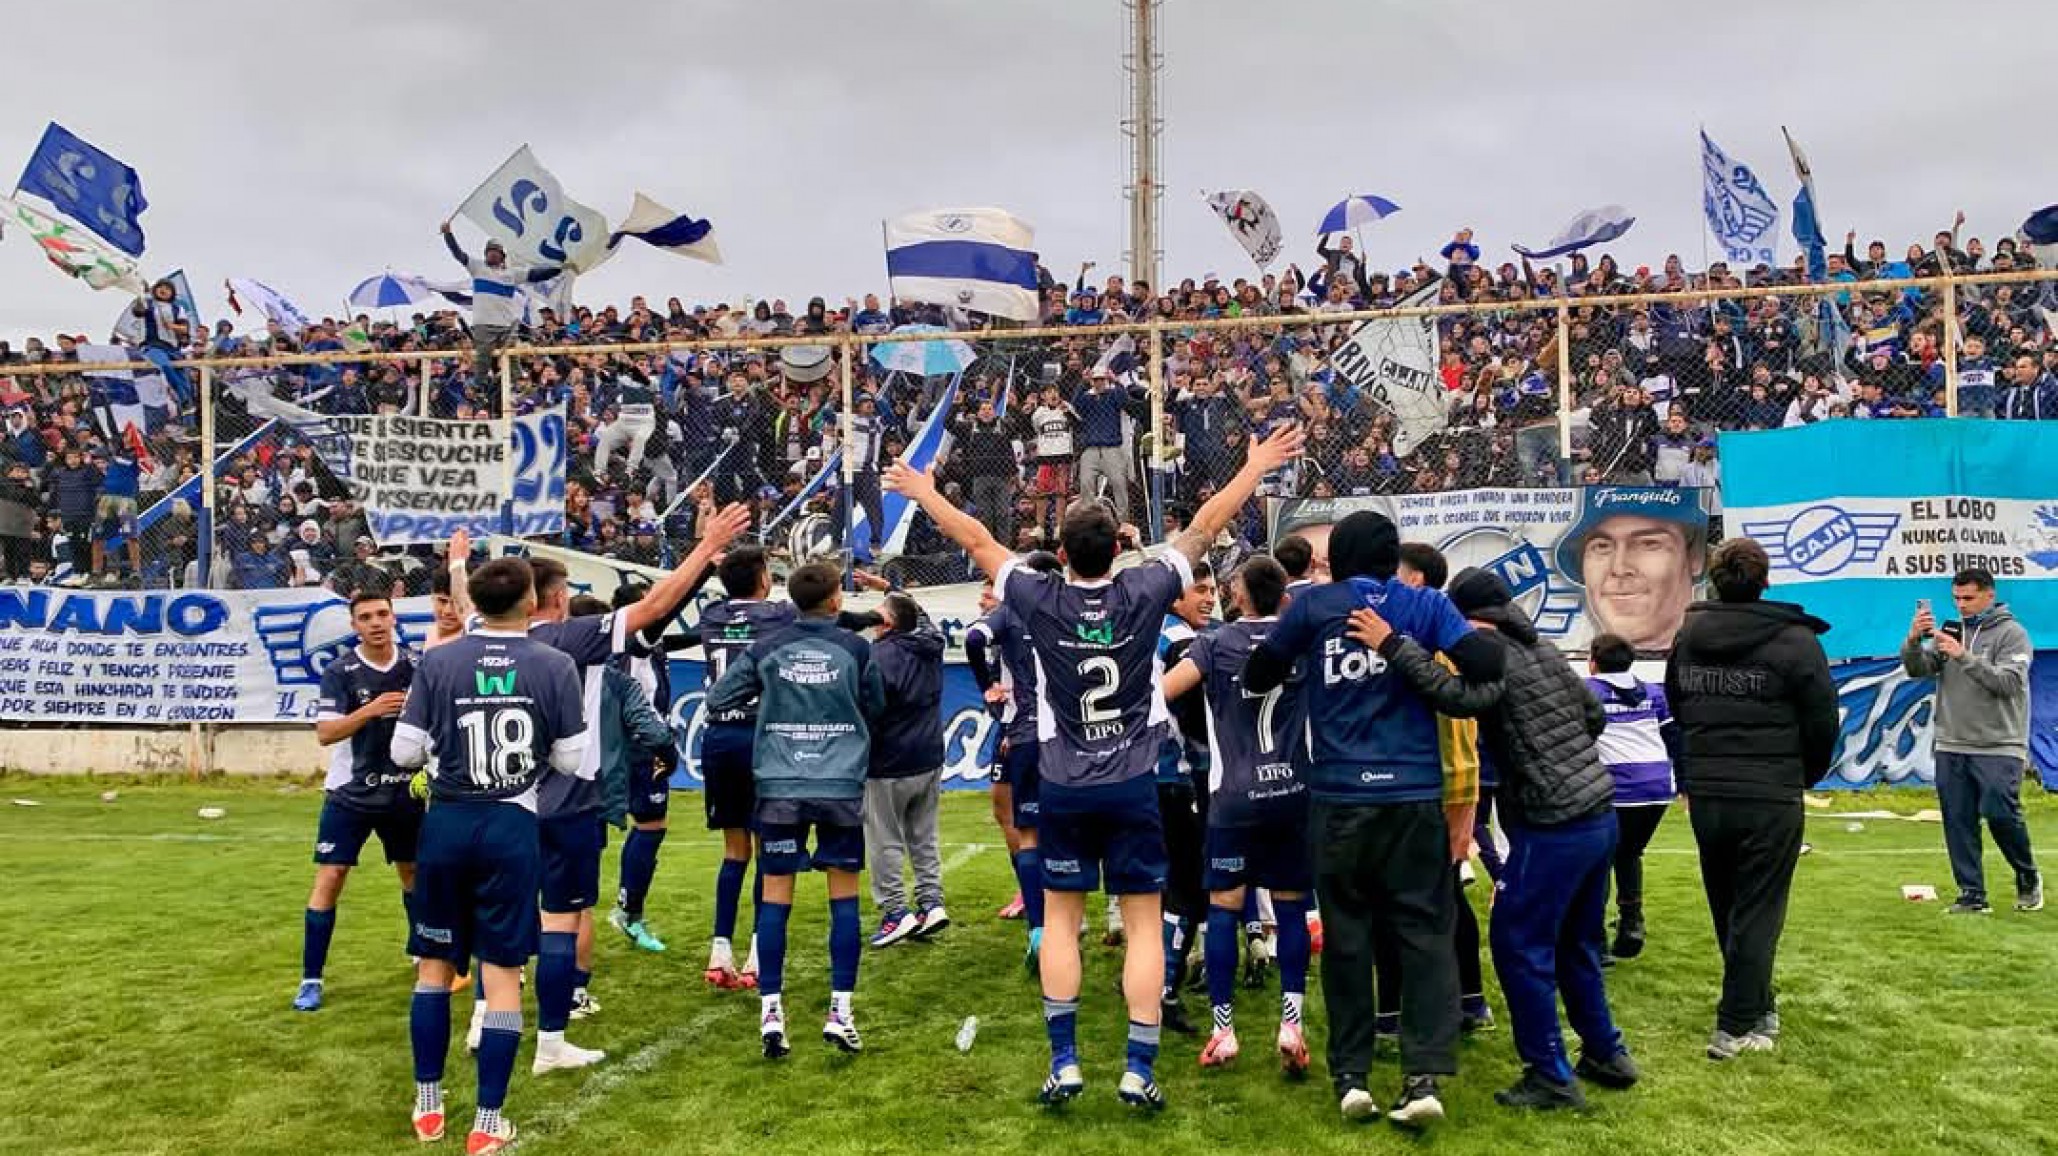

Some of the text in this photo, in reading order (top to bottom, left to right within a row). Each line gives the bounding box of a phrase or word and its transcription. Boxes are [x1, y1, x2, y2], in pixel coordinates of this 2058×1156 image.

[388, 417, 491, 440] SIENTA
[418, 468, 478, 487] VEA
[1911, 498, 1996, 521] EL LOBO
[1791, 515, 1853, 563] CAJN
[1901, 527, 2007, 546] NUNCA OLVIDA
[1886, 552, 2025, 575] A SUS HEROES
[66, 642, 115, 656] DONDE
[126, 642, 145, 656] TE
[1324, 637, 1345, 655] EL
[38, 660, 74, 676] FELIZ
[82, 663, 93, 677] Y
[101, 663, 159, 678] TENGAS
[1324, 649, 1388, 685] LOB
[75, 683, 153, 698] HINCHADA
[1077, 656, 1122, 722] 2
[1, 698, 35, 714] POR
[44, 701, 105, 715] SIEMPRE
[117, 703, 137, 718] EN
[457, 709, 536, 788] 18
